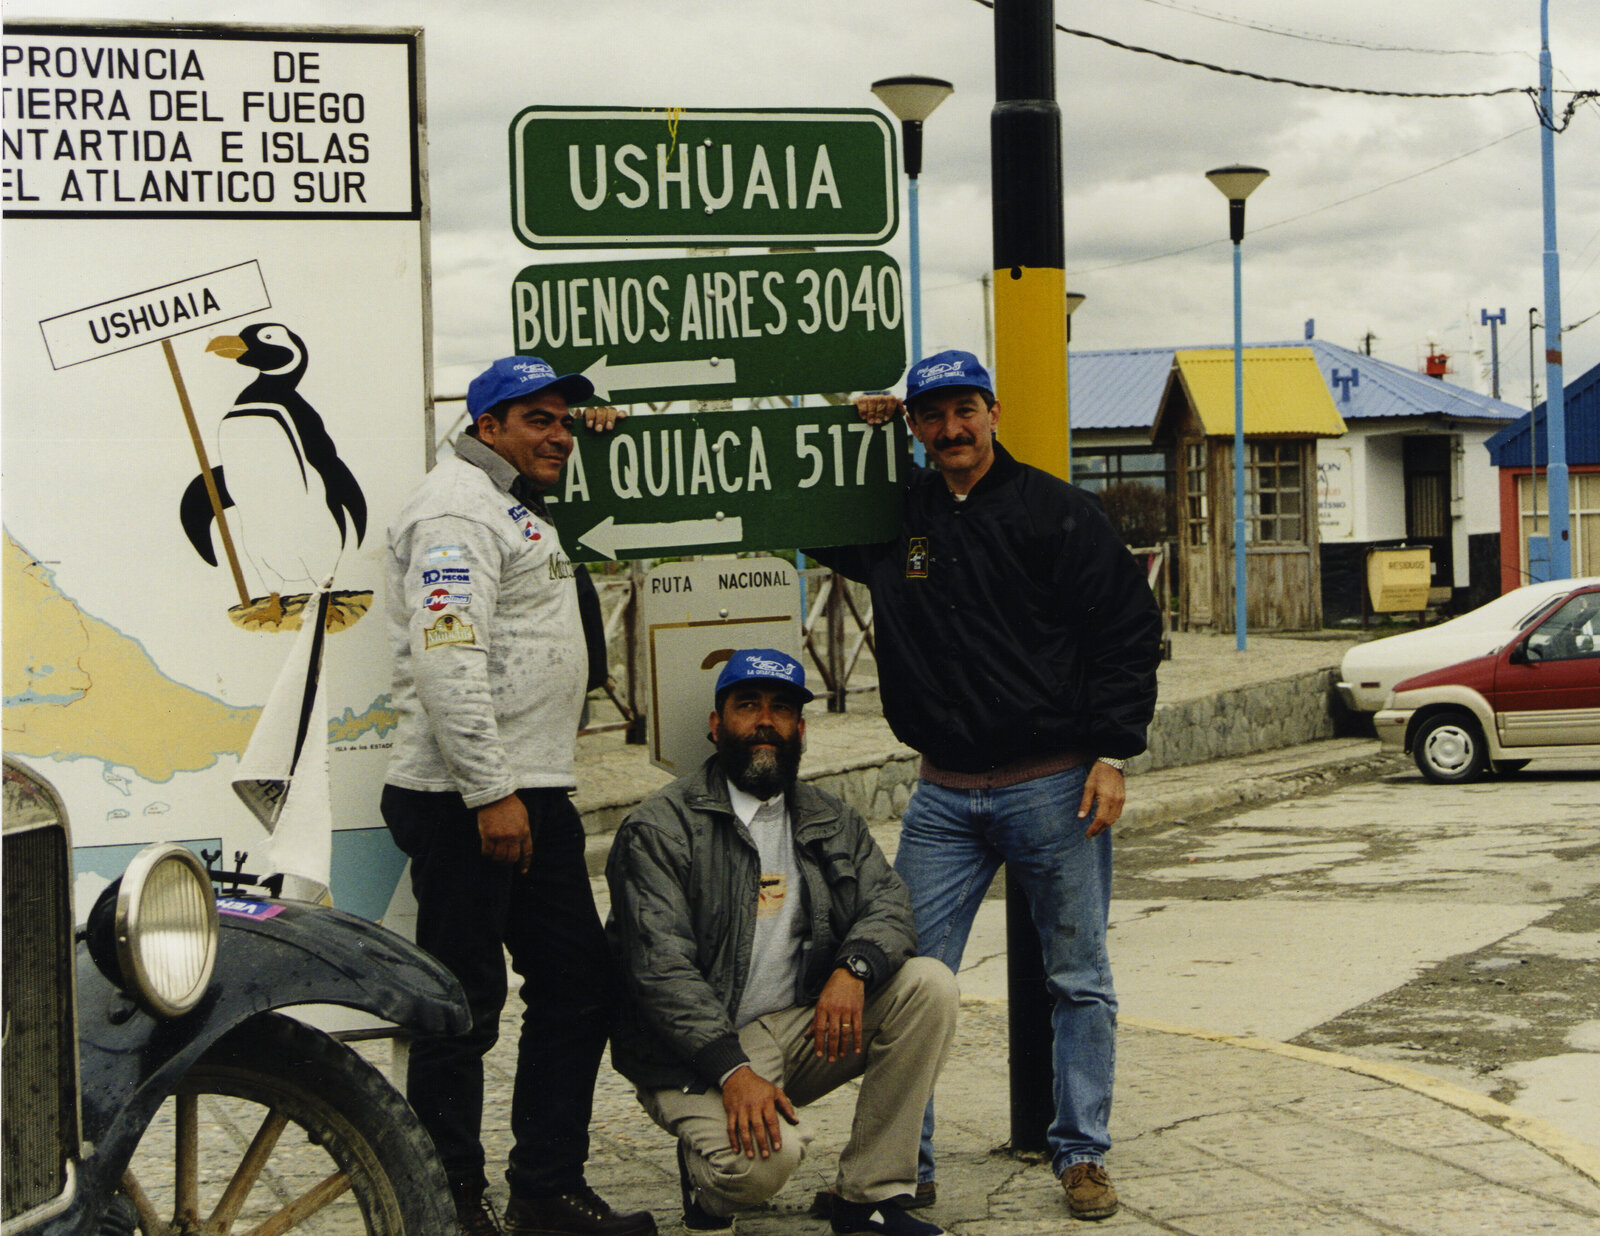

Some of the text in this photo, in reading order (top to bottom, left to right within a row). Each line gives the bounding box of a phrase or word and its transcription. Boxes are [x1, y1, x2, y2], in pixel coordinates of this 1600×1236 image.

[3, 45, 320, 84] PROVINCIA DE
[149, 89, 224, 122] DEL
[243, 91, 365, 124] FUEGO
[221, 131, 244, 163] E
[261, 131, 369, 164] ISLAS
[60, 169, 275, 203] ATLANTICO
[293, 171, 367, 204] SUR
[569, 143, 843, 211] USHUAIA
[88, 287, 221, 345] USHUAIA
[515, 264, 901, 350] BUENOS AIRES 3040
[544, 421, 897, 503] A QUIACA 5171
[652, 570, 791, 594] RUTA NACIONAL
